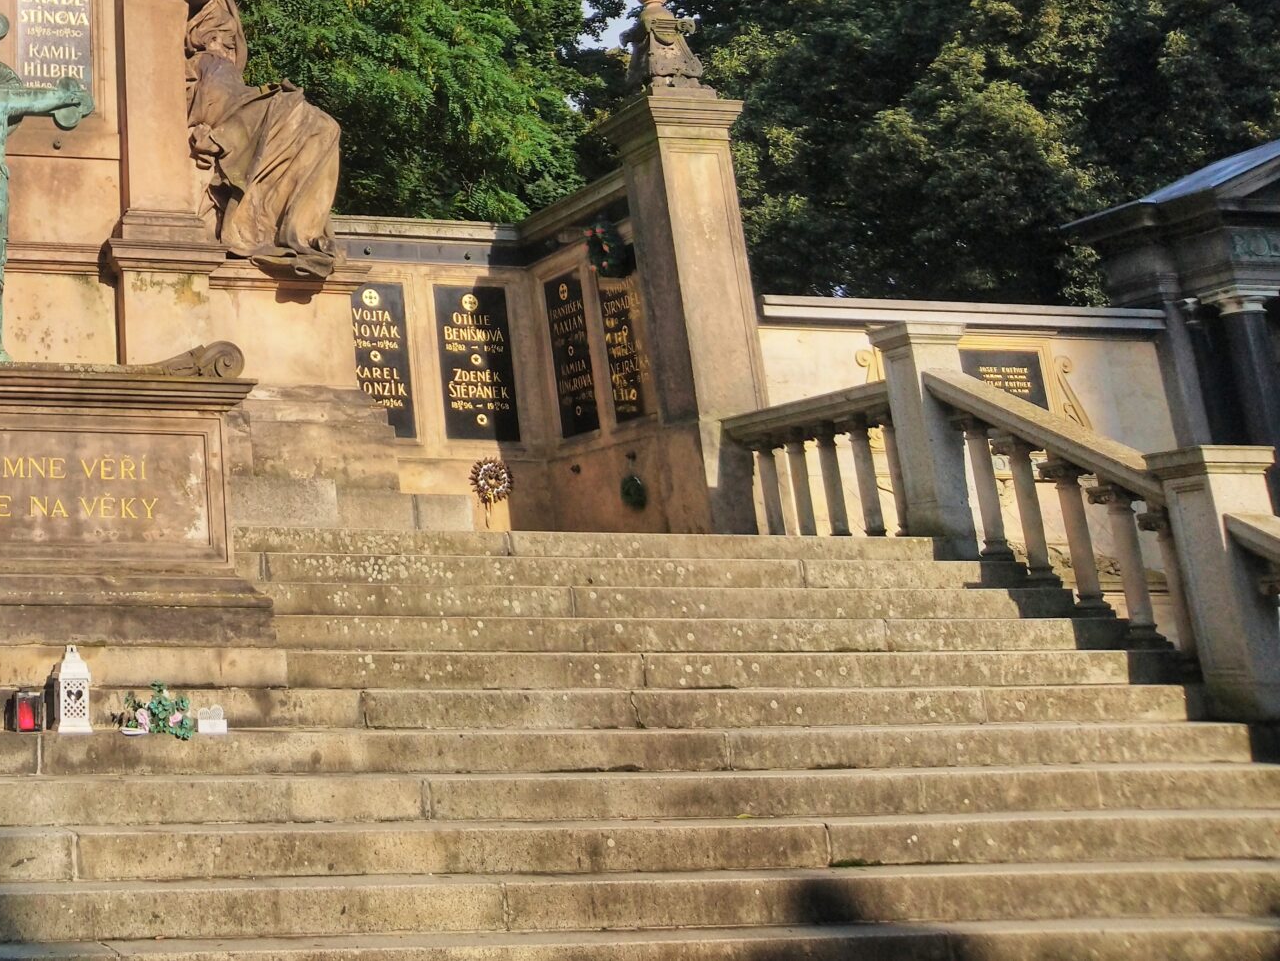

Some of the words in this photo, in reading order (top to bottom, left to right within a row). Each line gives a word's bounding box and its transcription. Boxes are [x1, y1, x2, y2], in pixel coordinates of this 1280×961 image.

[23, 59, 85, 79] HILBERT
[352, 307, 391, 322] VOJTA
[452, 311, 491, 326] OTILIE
[2, 456, 66, 479] MNE
[81, 454, 147, 480] VĚŘÍ
[29, 495, 69, 518] NA
[78, 492, 159, 519] VĚKY
